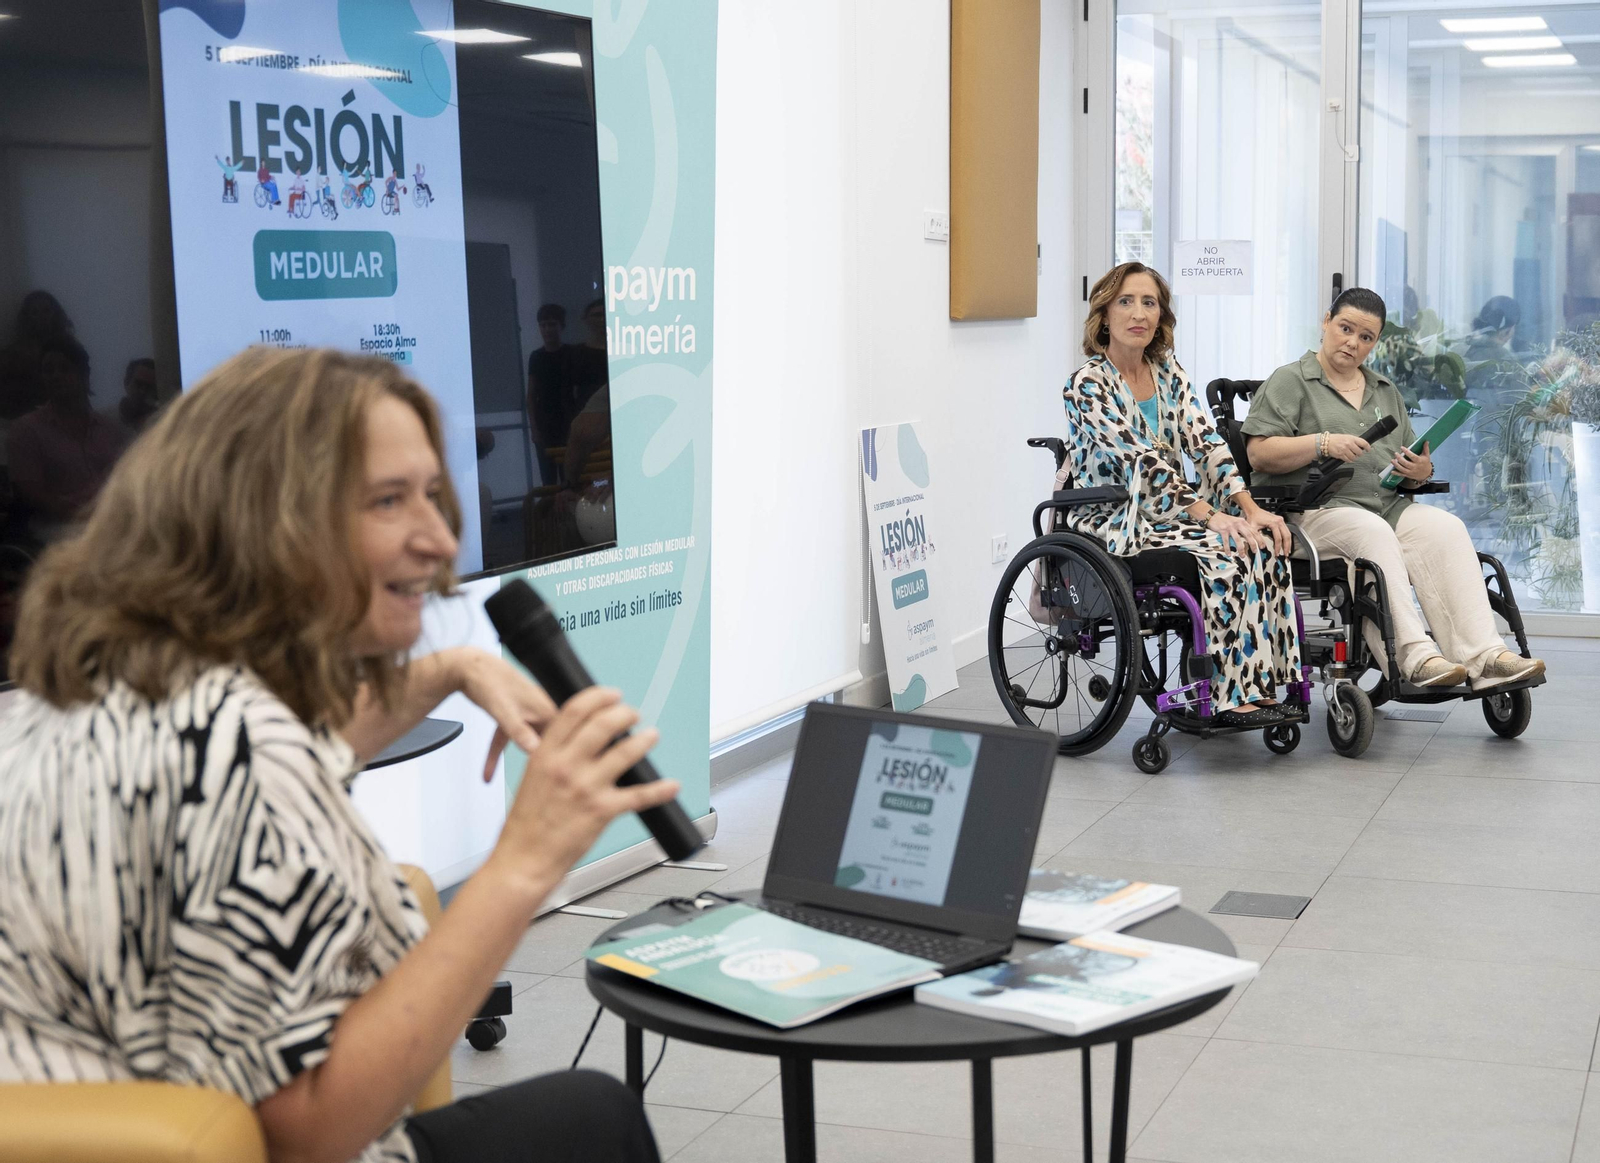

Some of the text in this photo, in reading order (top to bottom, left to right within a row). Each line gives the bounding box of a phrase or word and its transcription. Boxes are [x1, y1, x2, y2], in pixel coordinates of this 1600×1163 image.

[205, 45, 213, 62] 5
[229, 88, 405, 180] LESIÓN
[1204, 246, 1219, 255] NO
[269, 251, 384, 280] MEDULAR
[1196, 257, 1226, 266] ABRIR
[1181, 267, 1244, 277] ESTA PUERTA
[603, 265, 696, 313] paym
[259, 329, 292, 343] 11:00h
[372, 323, 401, 337] 18:30h
[359, 336, 417, 352] Espacio Alma
[880, 507, 927, 556] LESIÓN
[574, 556, 584, 570] DE
[585, 549, 624, 568] PERSONAS
[625, 546, 640, 561] CON
[640, 540, 664, 558] LESIÓN
[664, 535, 696, 554] MEDULAR
[555, 560, 674, 597] Y OTRAS DISCAPACIDADES FÍSICAS
[895, 578, 926, 601] MEDULAR
[558, 588, 683, 633] cia una vida sin límites
[913, 618, 935, 635] aspaym
[881, 756, 949, 784] LESIÓN
[884, 796, 929, 811] MEDULAR
